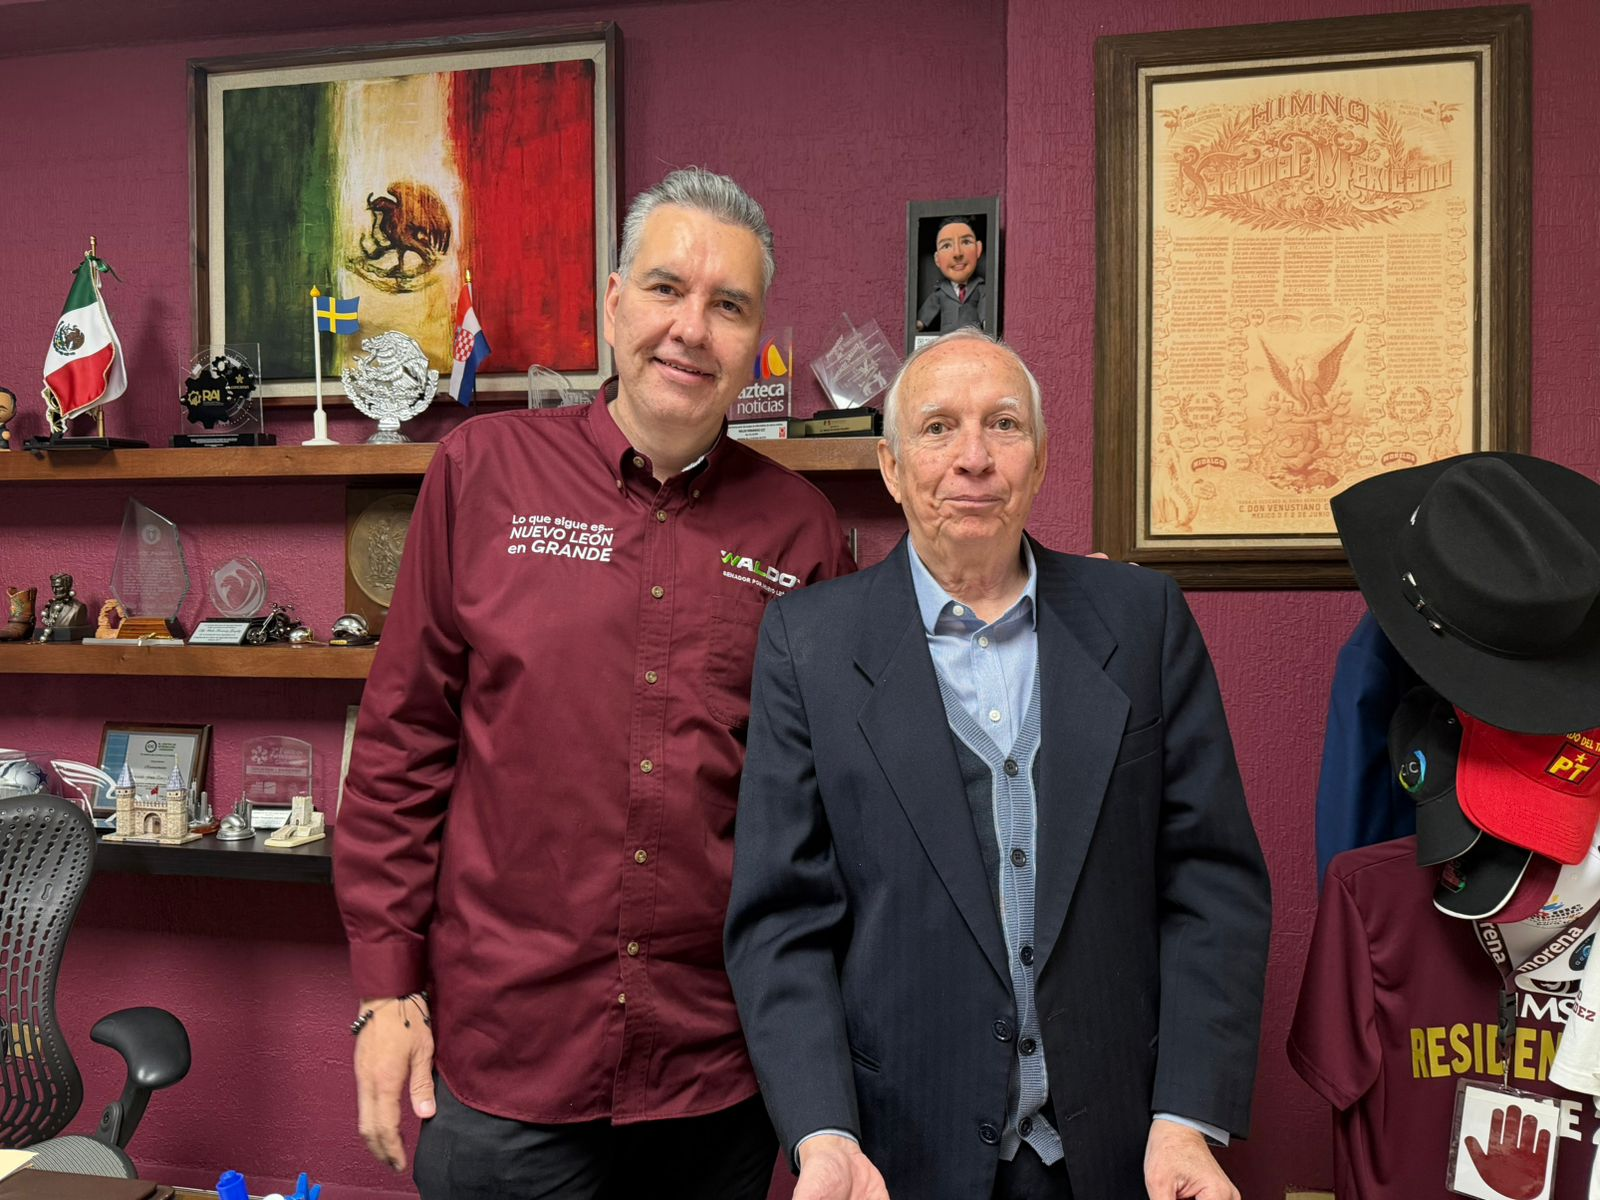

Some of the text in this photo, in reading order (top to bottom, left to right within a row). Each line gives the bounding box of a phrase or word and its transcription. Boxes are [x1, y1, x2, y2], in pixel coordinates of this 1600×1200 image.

[1251, 91, 1369, 130] HIMNO
[202, 390, 220, 402] RAI
[737, 382, 785, 399] azteca
[737, 398, 785, 414] noticias
[1267, 503, 1321, 512] VENUSTIANO
[512, 514, 526, 524] Lo
[528, 515, 552, 525] que
[554, 516, 588, 530] sigue
[509, 526, 614, 546] NUEVO LEÓN
[507, 540, 613, 562] en GRANDE
[720, 550, 797, 588] WALDO
[722, 570, 751, 583] SENADOR
[1580, 736, 1594, 750] DEL
[1550, 755, 1590, 781] PT
[1516, 927, 1584, 974] morena
